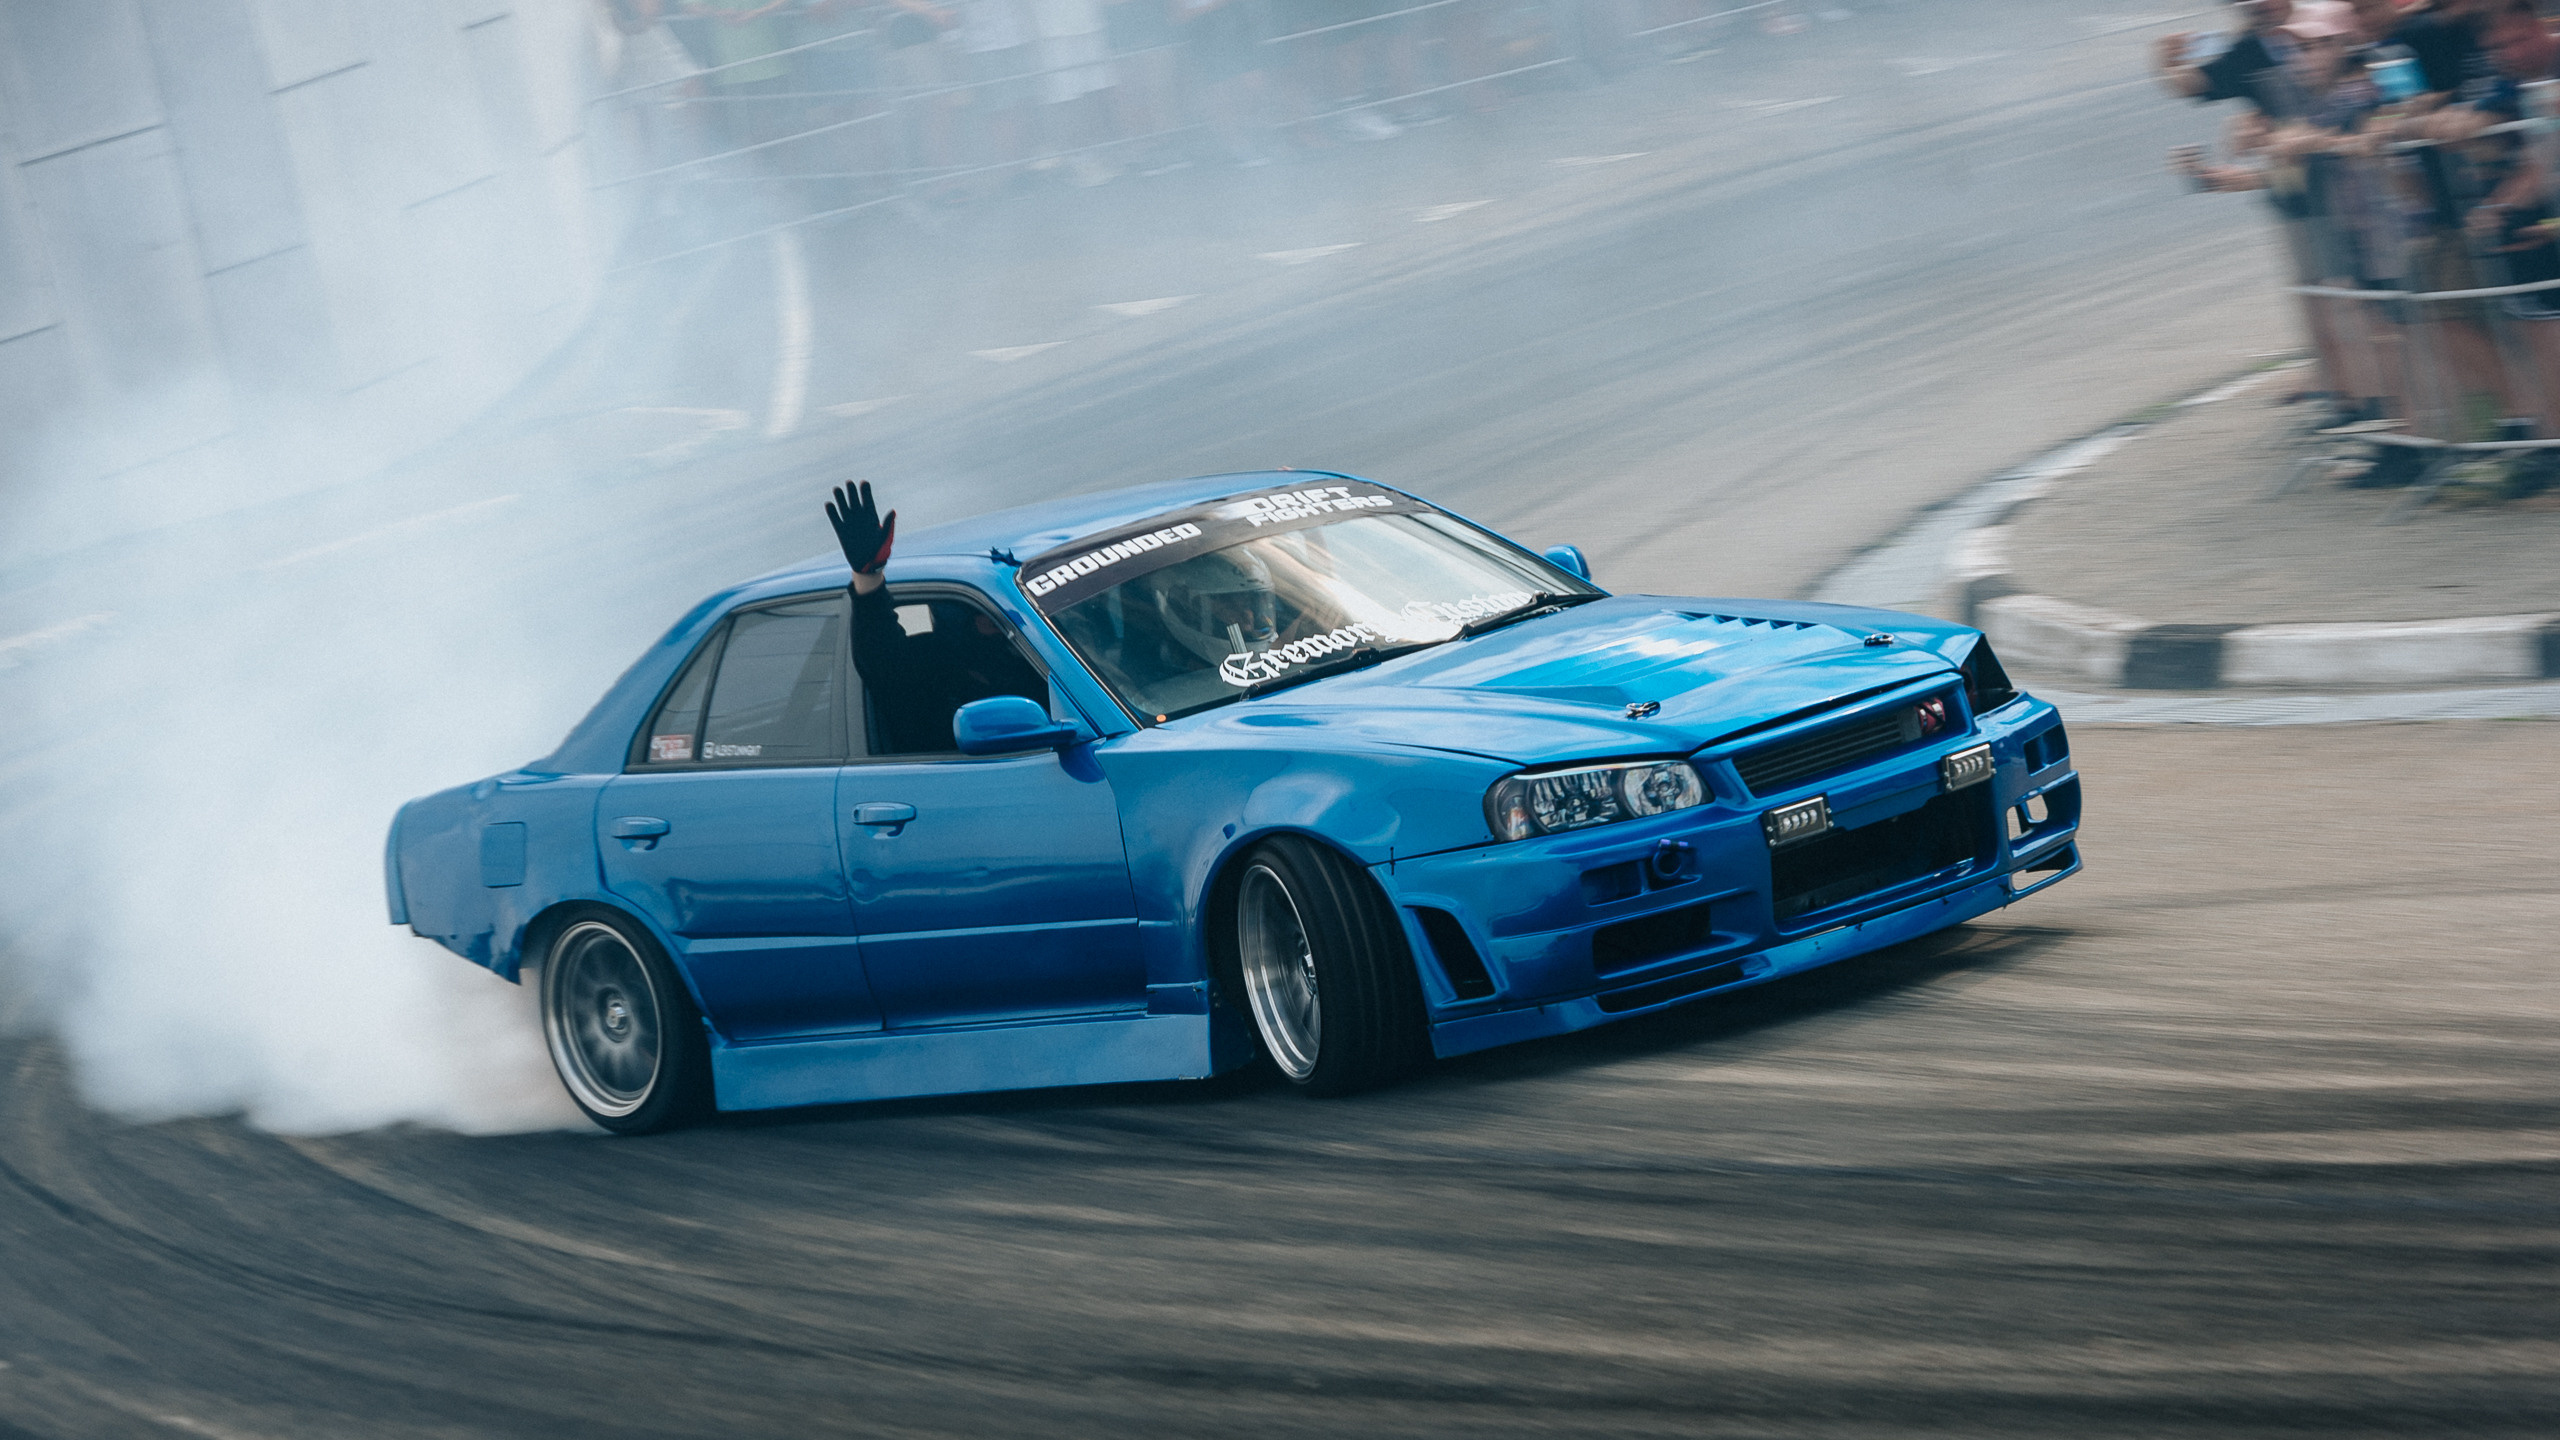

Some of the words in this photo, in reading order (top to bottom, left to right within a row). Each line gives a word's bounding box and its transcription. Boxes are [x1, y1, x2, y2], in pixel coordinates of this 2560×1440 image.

[1245, 486, 1351, 517] DRIFT
[1246, 495, 1393, 528] FIGHTERS
[1025, 522, 1202, 598] GROUNDED
